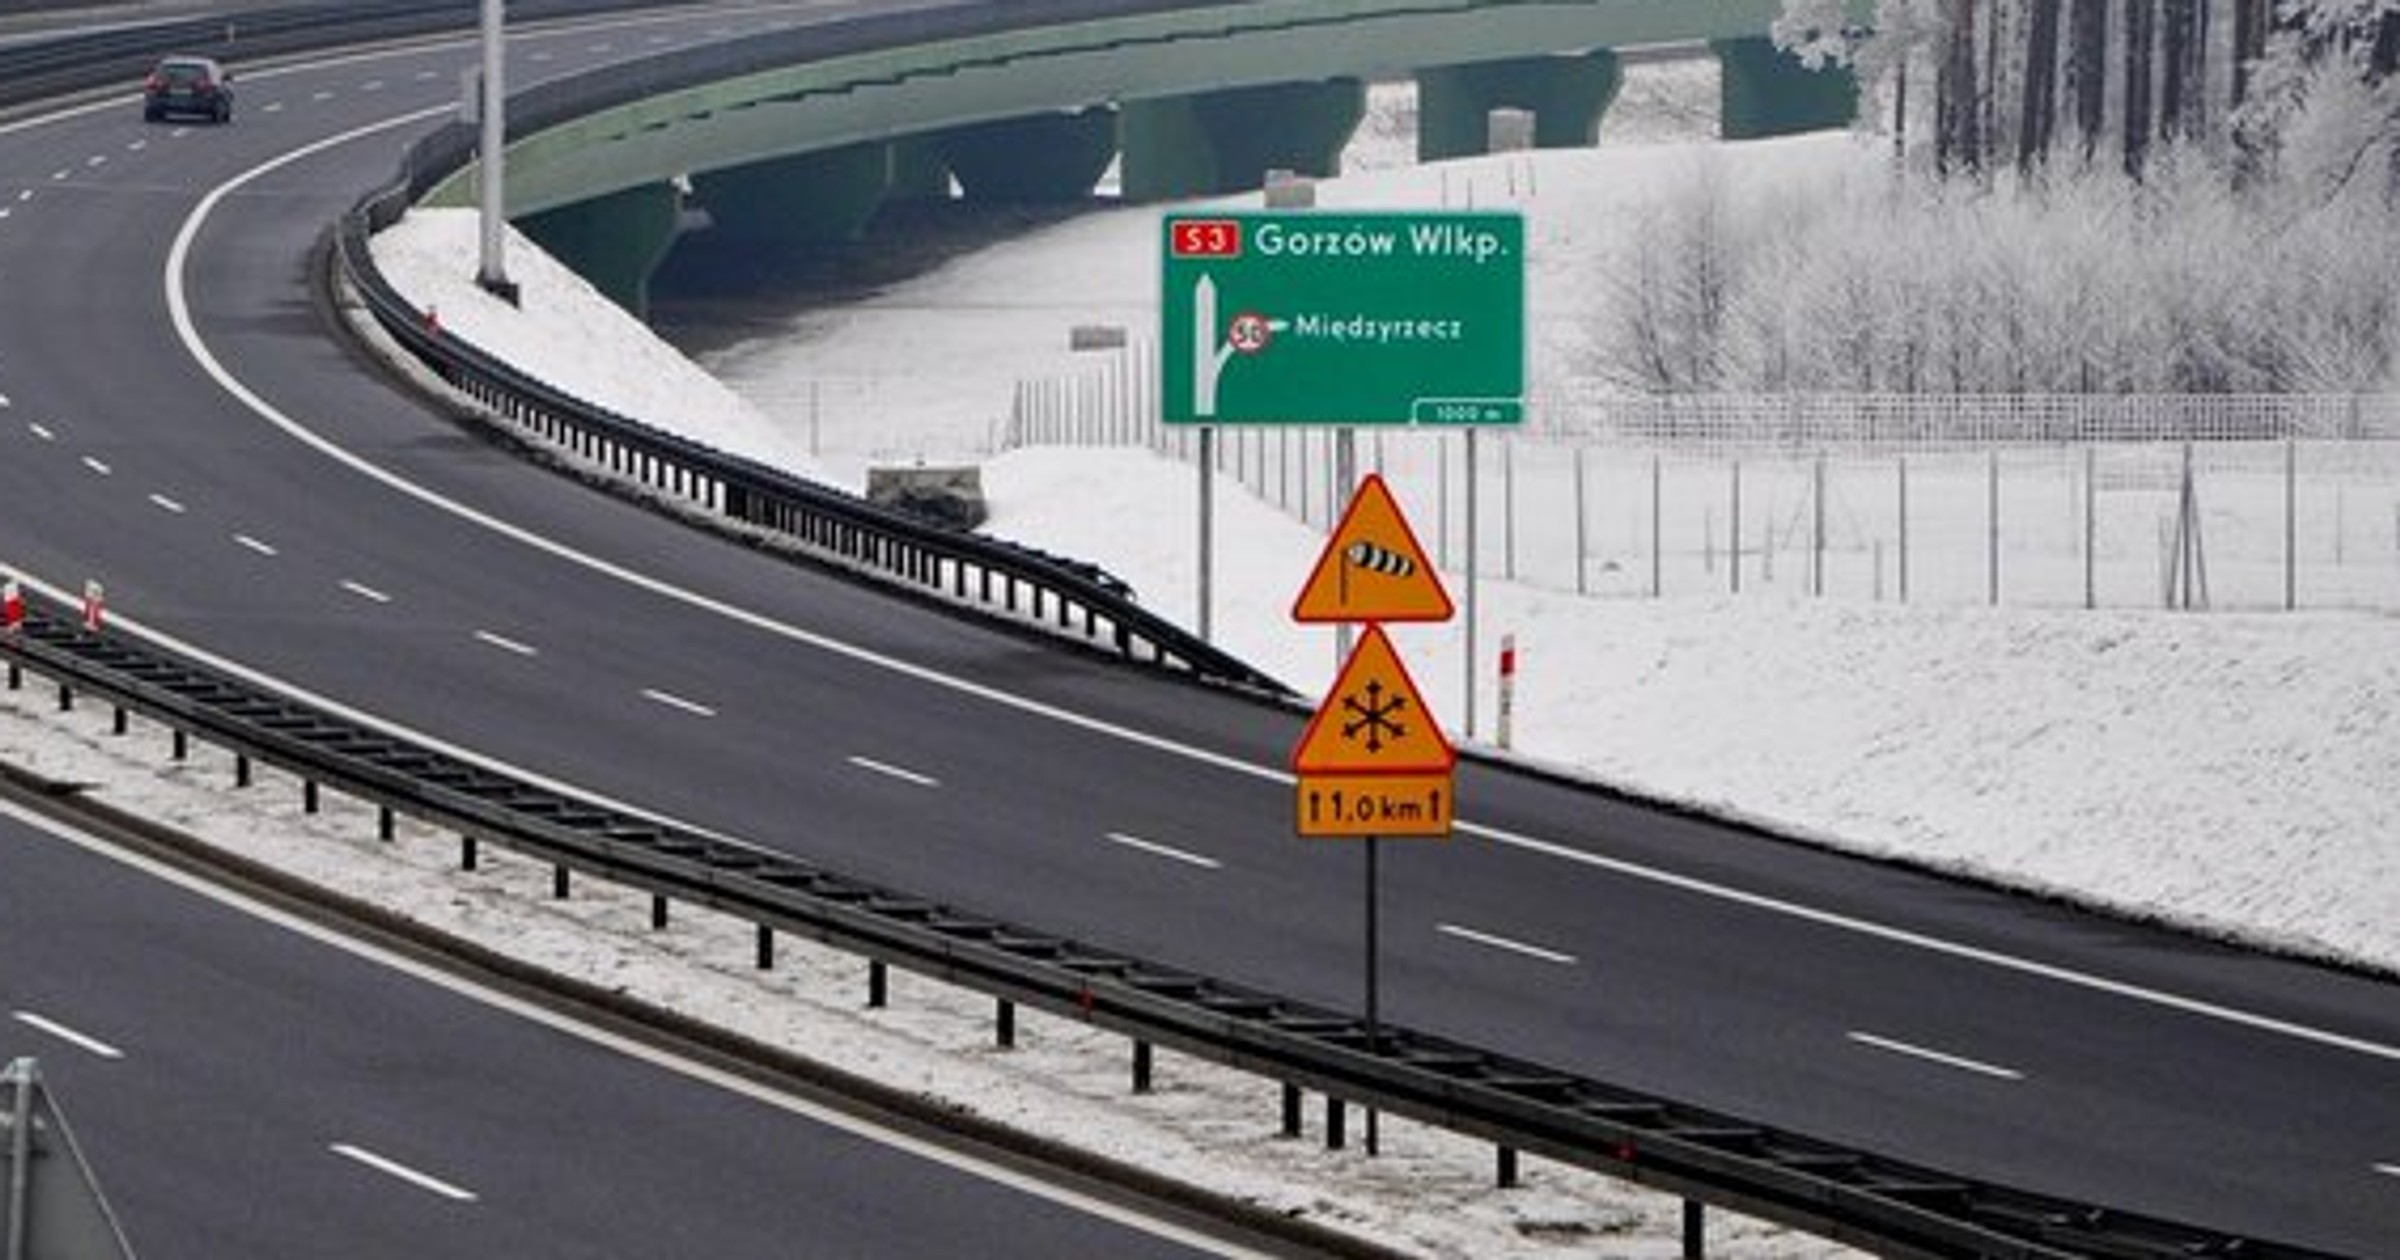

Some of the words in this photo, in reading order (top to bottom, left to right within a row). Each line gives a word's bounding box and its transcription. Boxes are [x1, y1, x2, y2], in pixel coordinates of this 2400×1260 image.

[1255, 223, 1396, 255] Gorzów
[1408, 223, 1508, 264] Wlkp.
[1295, 313, 1462, 343] Międzyrzecz
[1381, 796, 1421, 821] km
